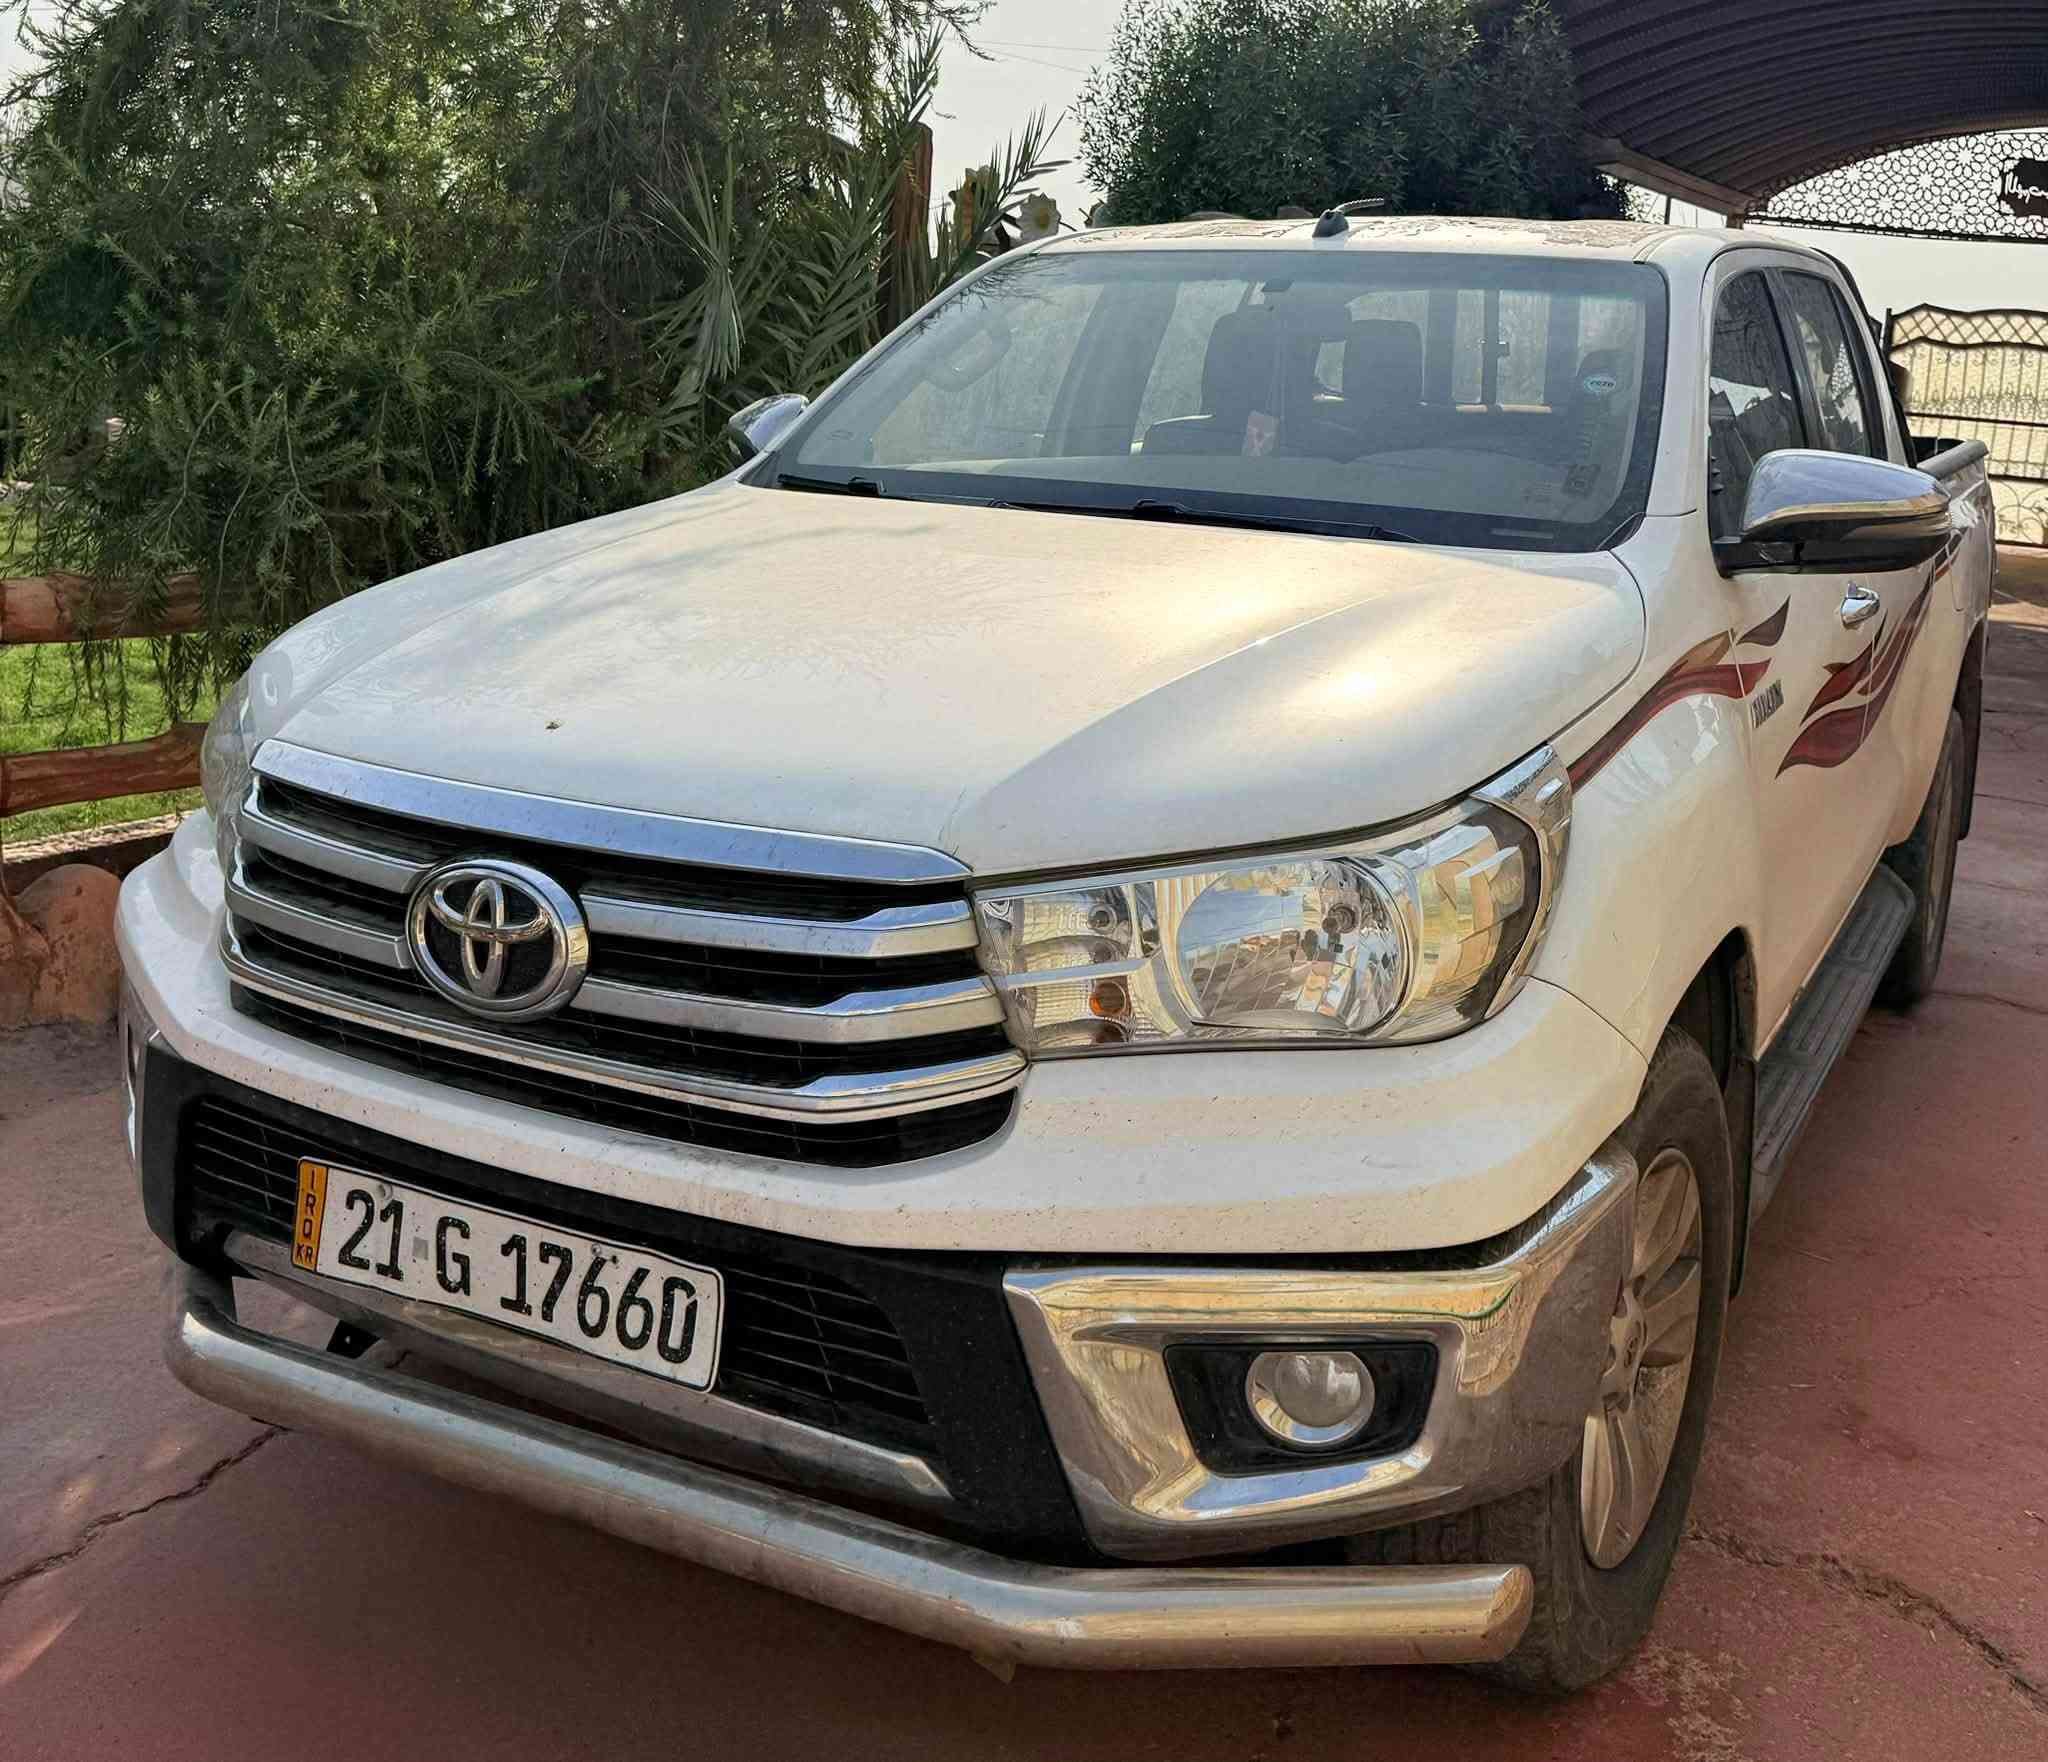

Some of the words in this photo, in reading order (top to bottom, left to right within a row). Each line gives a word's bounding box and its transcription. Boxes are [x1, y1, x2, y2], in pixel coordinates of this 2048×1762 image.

[295, 1242, 315, 1265] KR
[338, 1188, 405, 1282] 21
[435, 1215, 471, 1297] G
[499, 1233, 699, 1365] 17660
